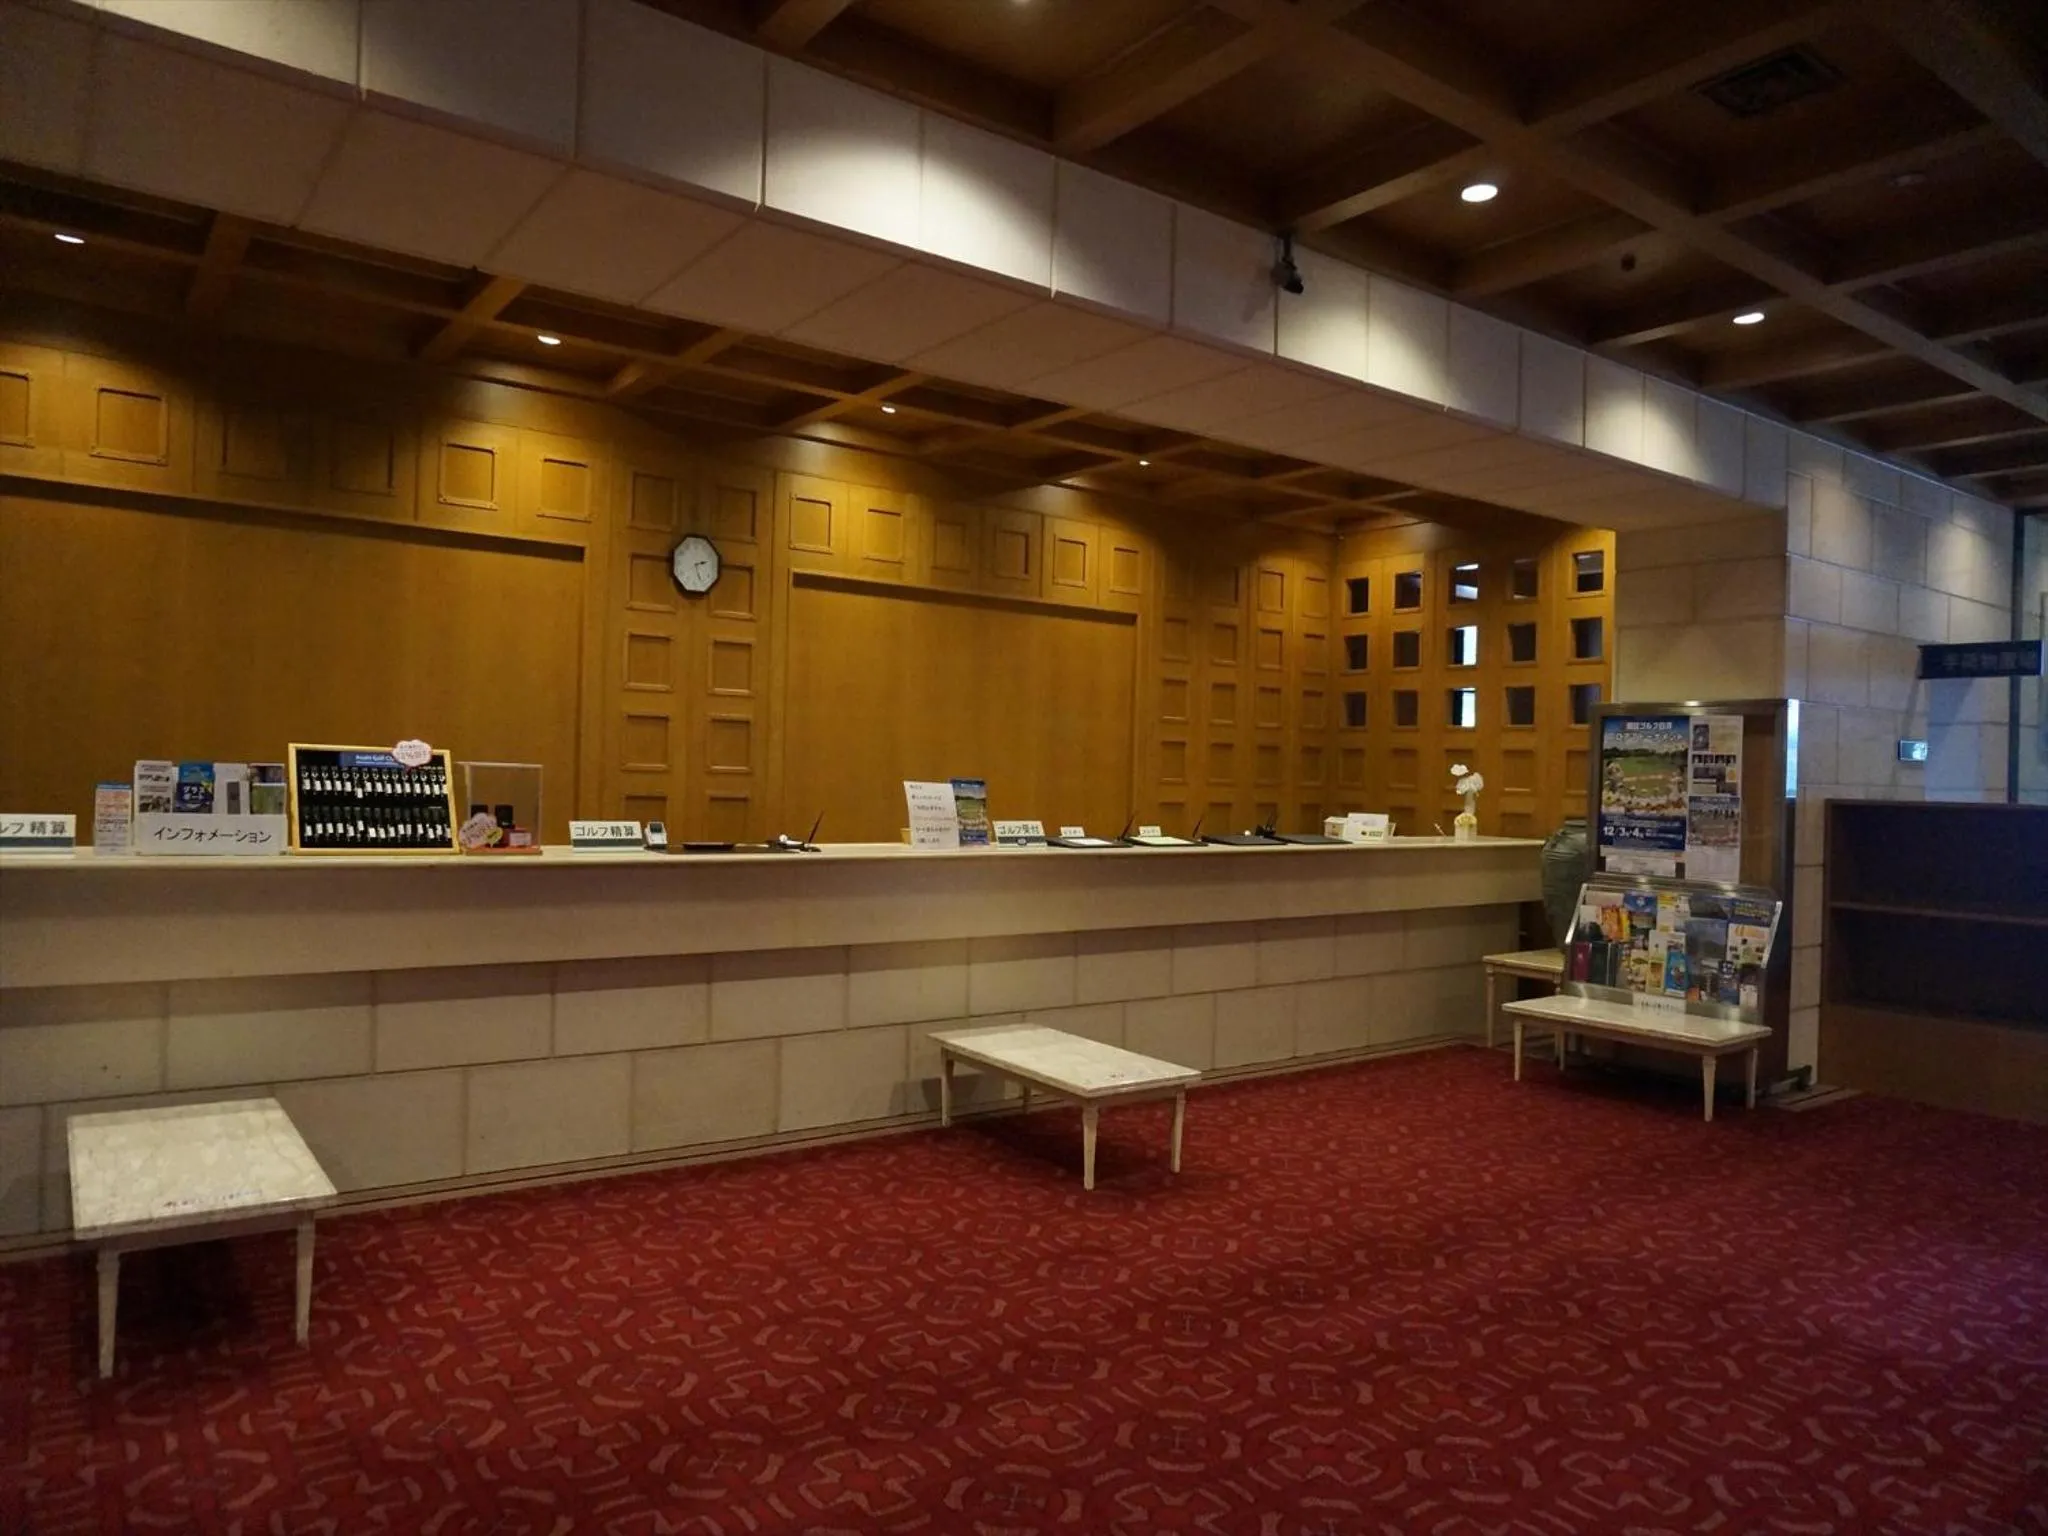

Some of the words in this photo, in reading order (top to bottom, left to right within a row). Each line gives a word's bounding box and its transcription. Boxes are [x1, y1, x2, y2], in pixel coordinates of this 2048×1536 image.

[154, 826, 271, 843] インフォメーション
[573, 824, 637, 838] ゴルフ精算
[997, 824, 1040, 835] ゴルフ受付
